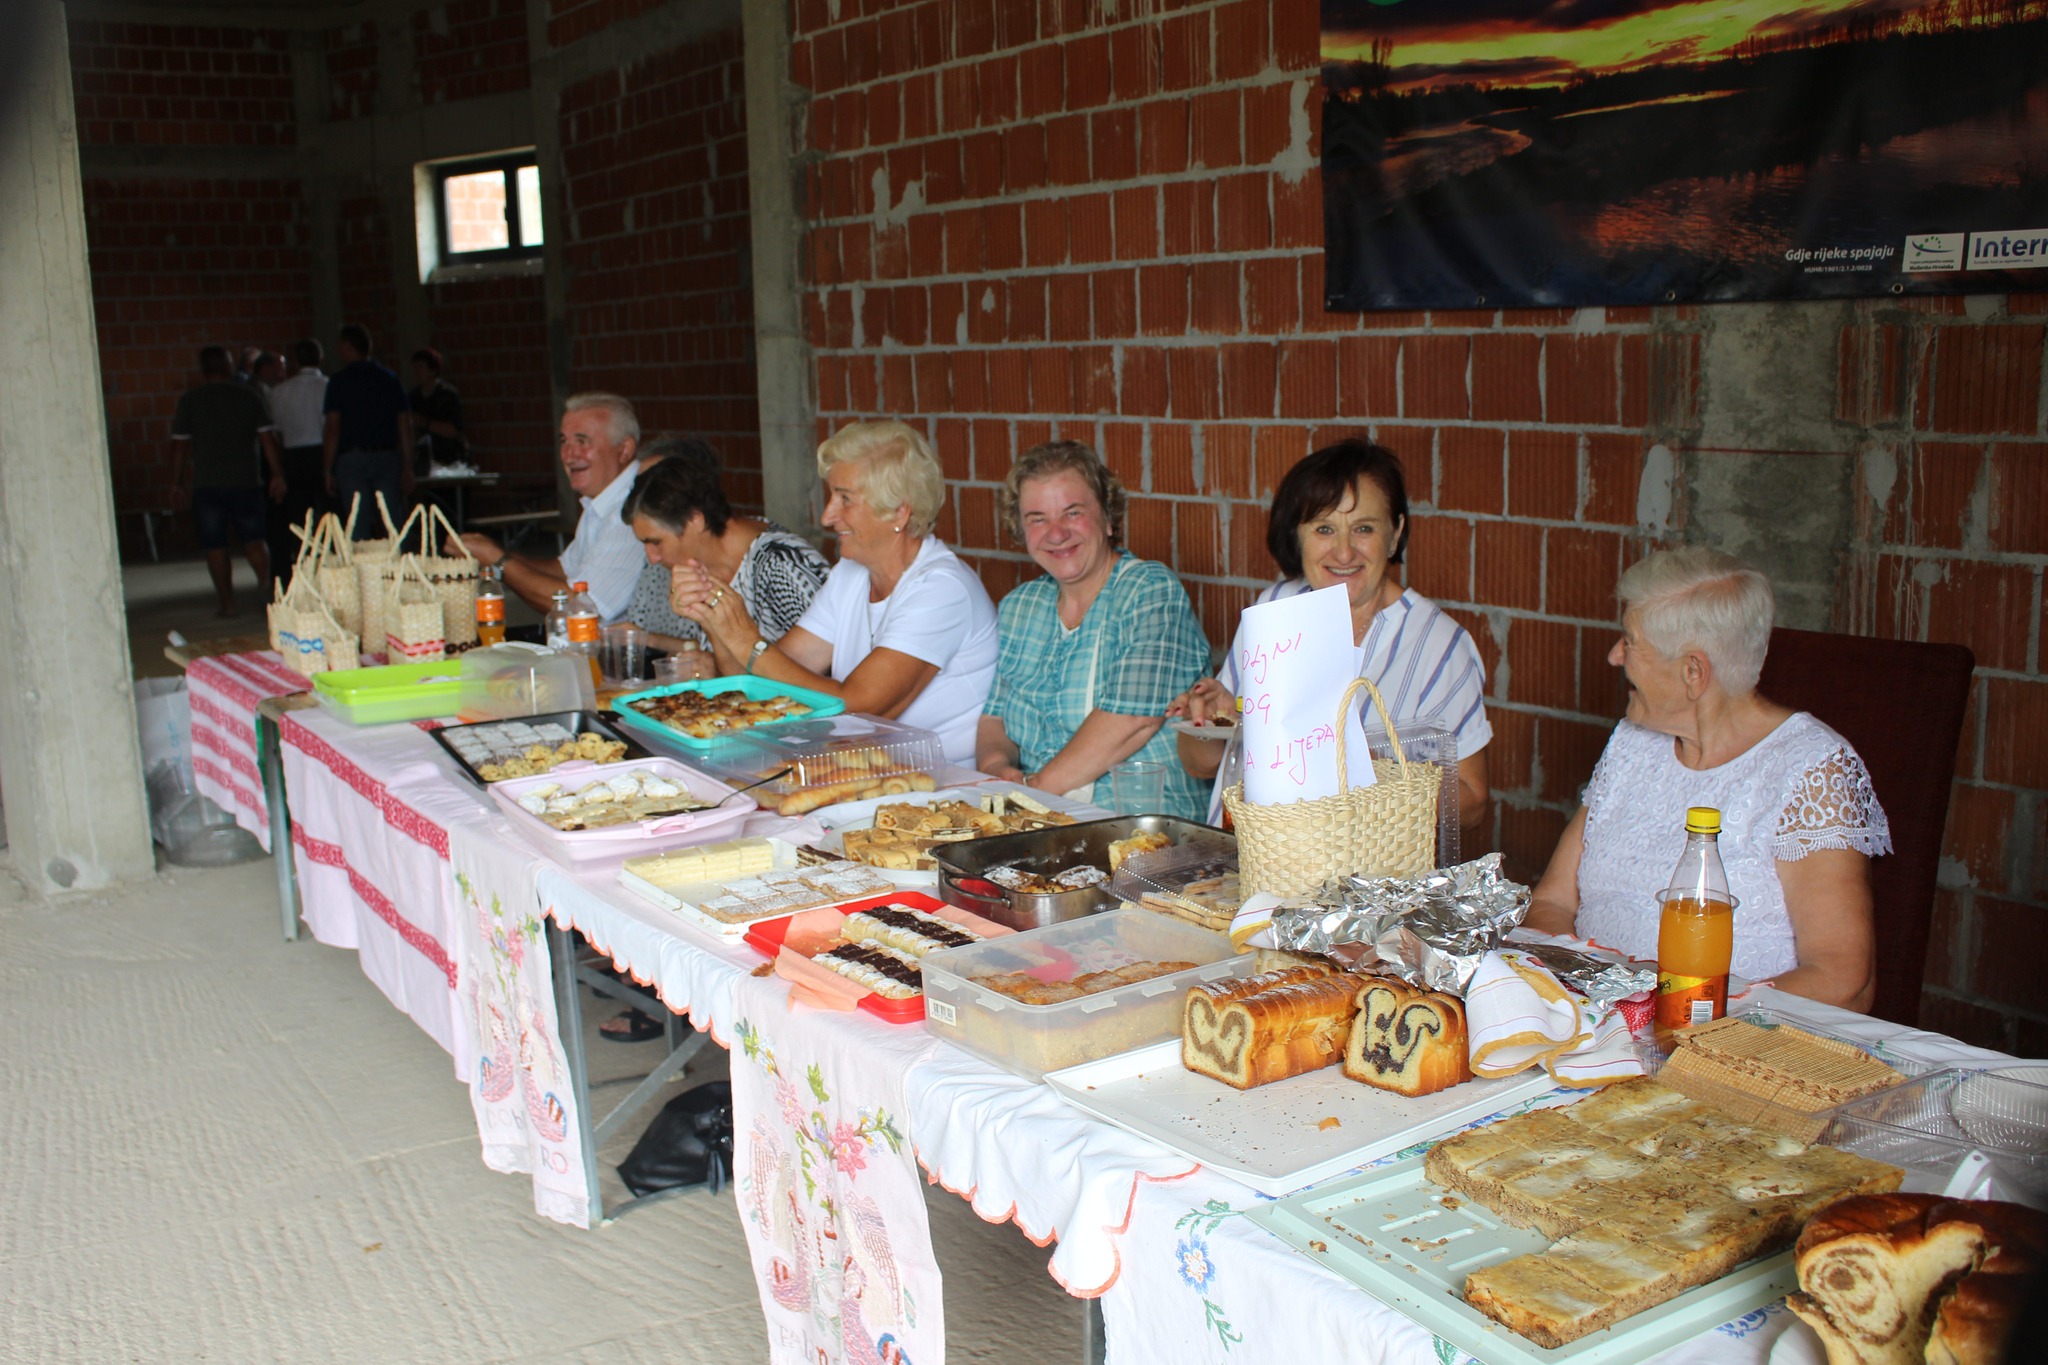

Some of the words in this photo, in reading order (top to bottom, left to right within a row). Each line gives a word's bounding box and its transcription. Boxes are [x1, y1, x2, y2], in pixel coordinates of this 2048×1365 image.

[1785, 248, 1812, 263] Gdje
[1813, 246, 1848, 263] rijeke
[1849, 244, 1895, 261] spajaju
[1270, 723, 1335, 786] LIJEPA
